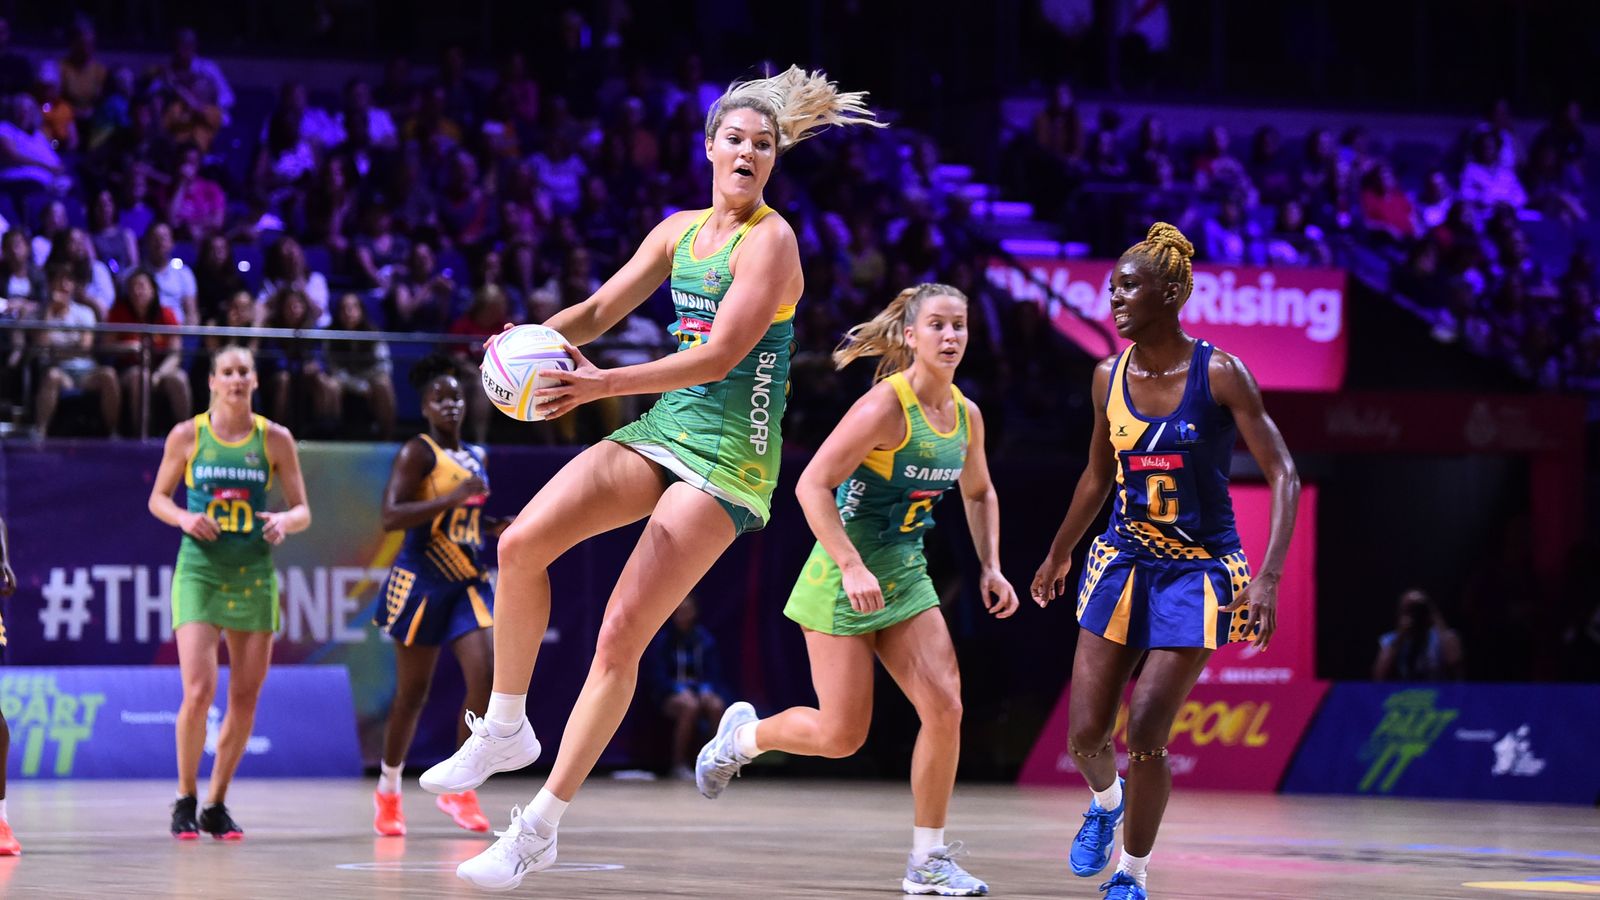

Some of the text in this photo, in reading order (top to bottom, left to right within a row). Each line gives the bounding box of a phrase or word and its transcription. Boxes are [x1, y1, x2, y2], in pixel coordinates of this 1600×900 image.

[483, 370, 514, 401] BERT
[750, 351, 777, 456] SUNCORP
[195, 466, 266, 482] SAMSUNG
[903, 464, 963, 481] SAMSU
[1141, 456, 1171, 471] Vitality
[207, 499, 253, 533] GD
[839, 479, 867, 528] SUNC
[1146, 473, 1179, 524] C
[449, 507, 482, 545] GA
[22, 727, 92, 777] IT
